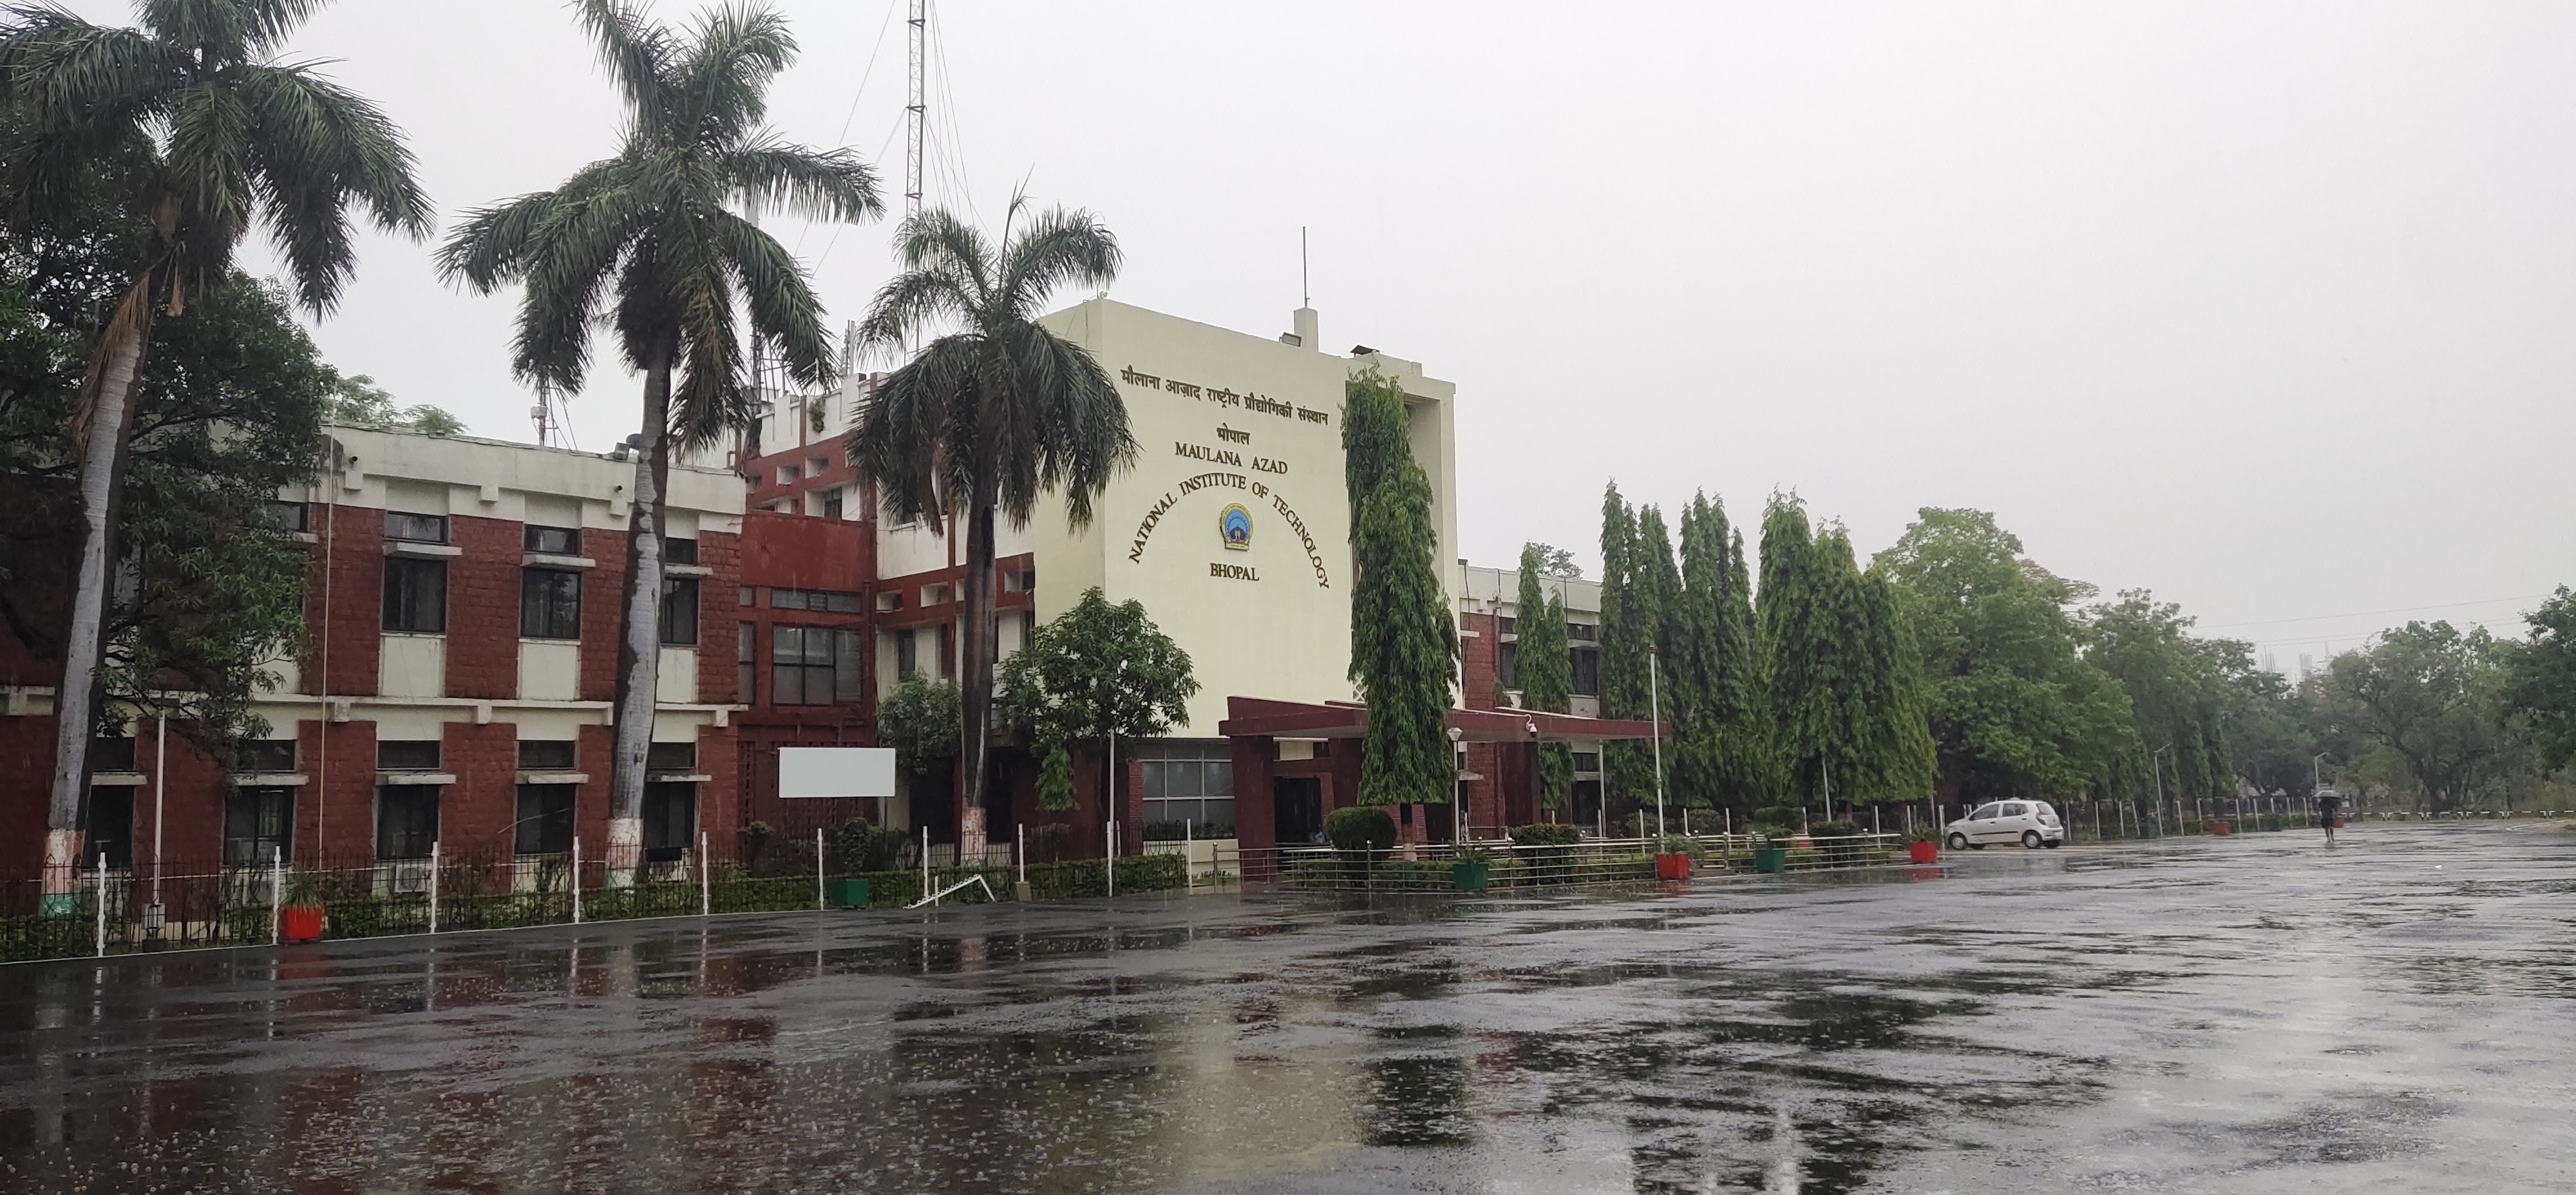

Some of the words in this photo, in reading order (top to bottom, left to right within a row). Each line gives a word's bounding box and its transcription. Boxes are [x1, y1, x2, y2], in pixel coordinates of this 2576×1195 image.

[1121, 364, 1160, 390] मौलाना
[1165, 379, 1201, 401] आज़ाद
[1206, 387, 1240, 409] राष्ट्रीय
[1244, 391, 1293, 419] प्रौद्योगिकी
[1296, 406, 1329, 426] संस्थान
[1217, 422, 1250, 446] भोपाल
[1175, 442, 1242, 467] MAULANA
[1251, 456, 1288, 475] AZAD
[1128, 492, 1177, 565] NATIONAL
[1179, 473, 1246, 496] INSTITUTE
[1252, 482, 1269, 498] OF
[1273, 494, 1329, 589] TECHNOLOGY
[1210, 562, 1260, 581] BHOPAL
